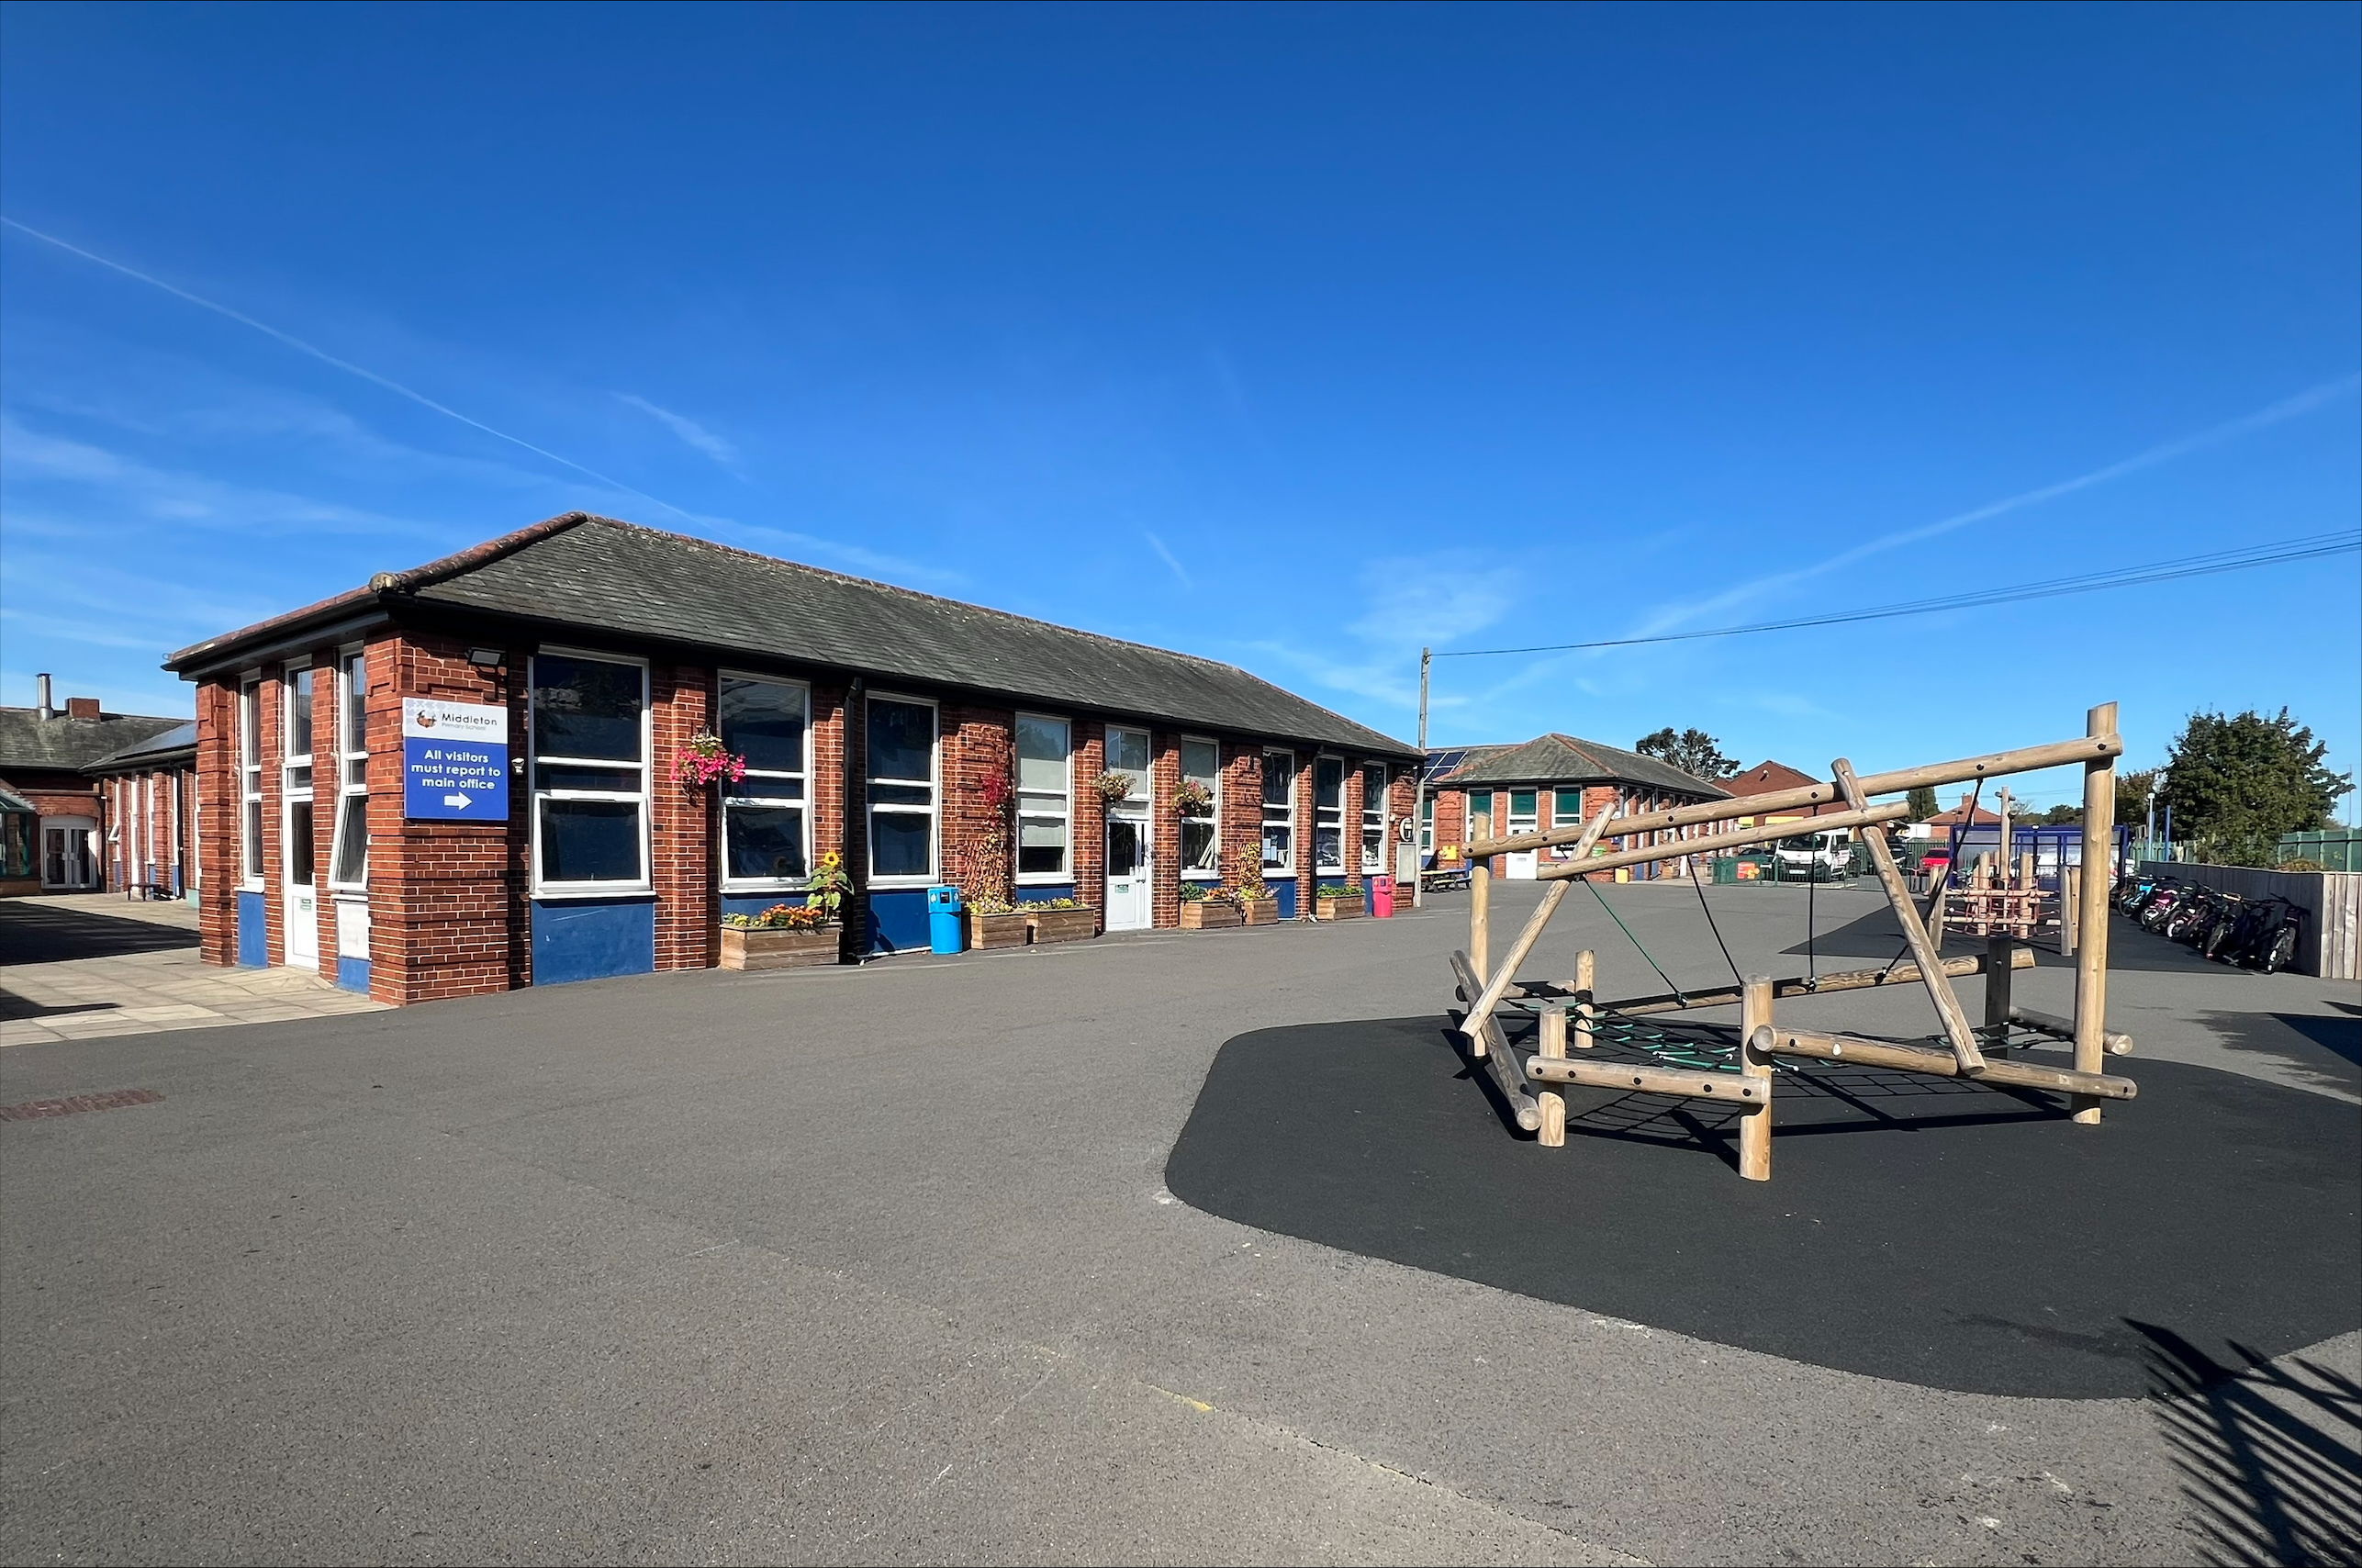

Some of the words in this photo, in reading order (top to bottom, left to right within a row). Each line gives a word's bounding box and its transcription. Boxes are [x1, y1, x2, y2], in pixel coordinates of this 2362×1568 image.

[442, 713, 498, 725] Middleton
[424, 749, 442, 760] All
[445, 751, 488, 763] visitors
[411, 764, 442, 774] must
[446, 766, 485, 777] report
[488, 767, 501, 777] to
[421, 778, 455, 788] main
[459, 778, 495, 790] office
